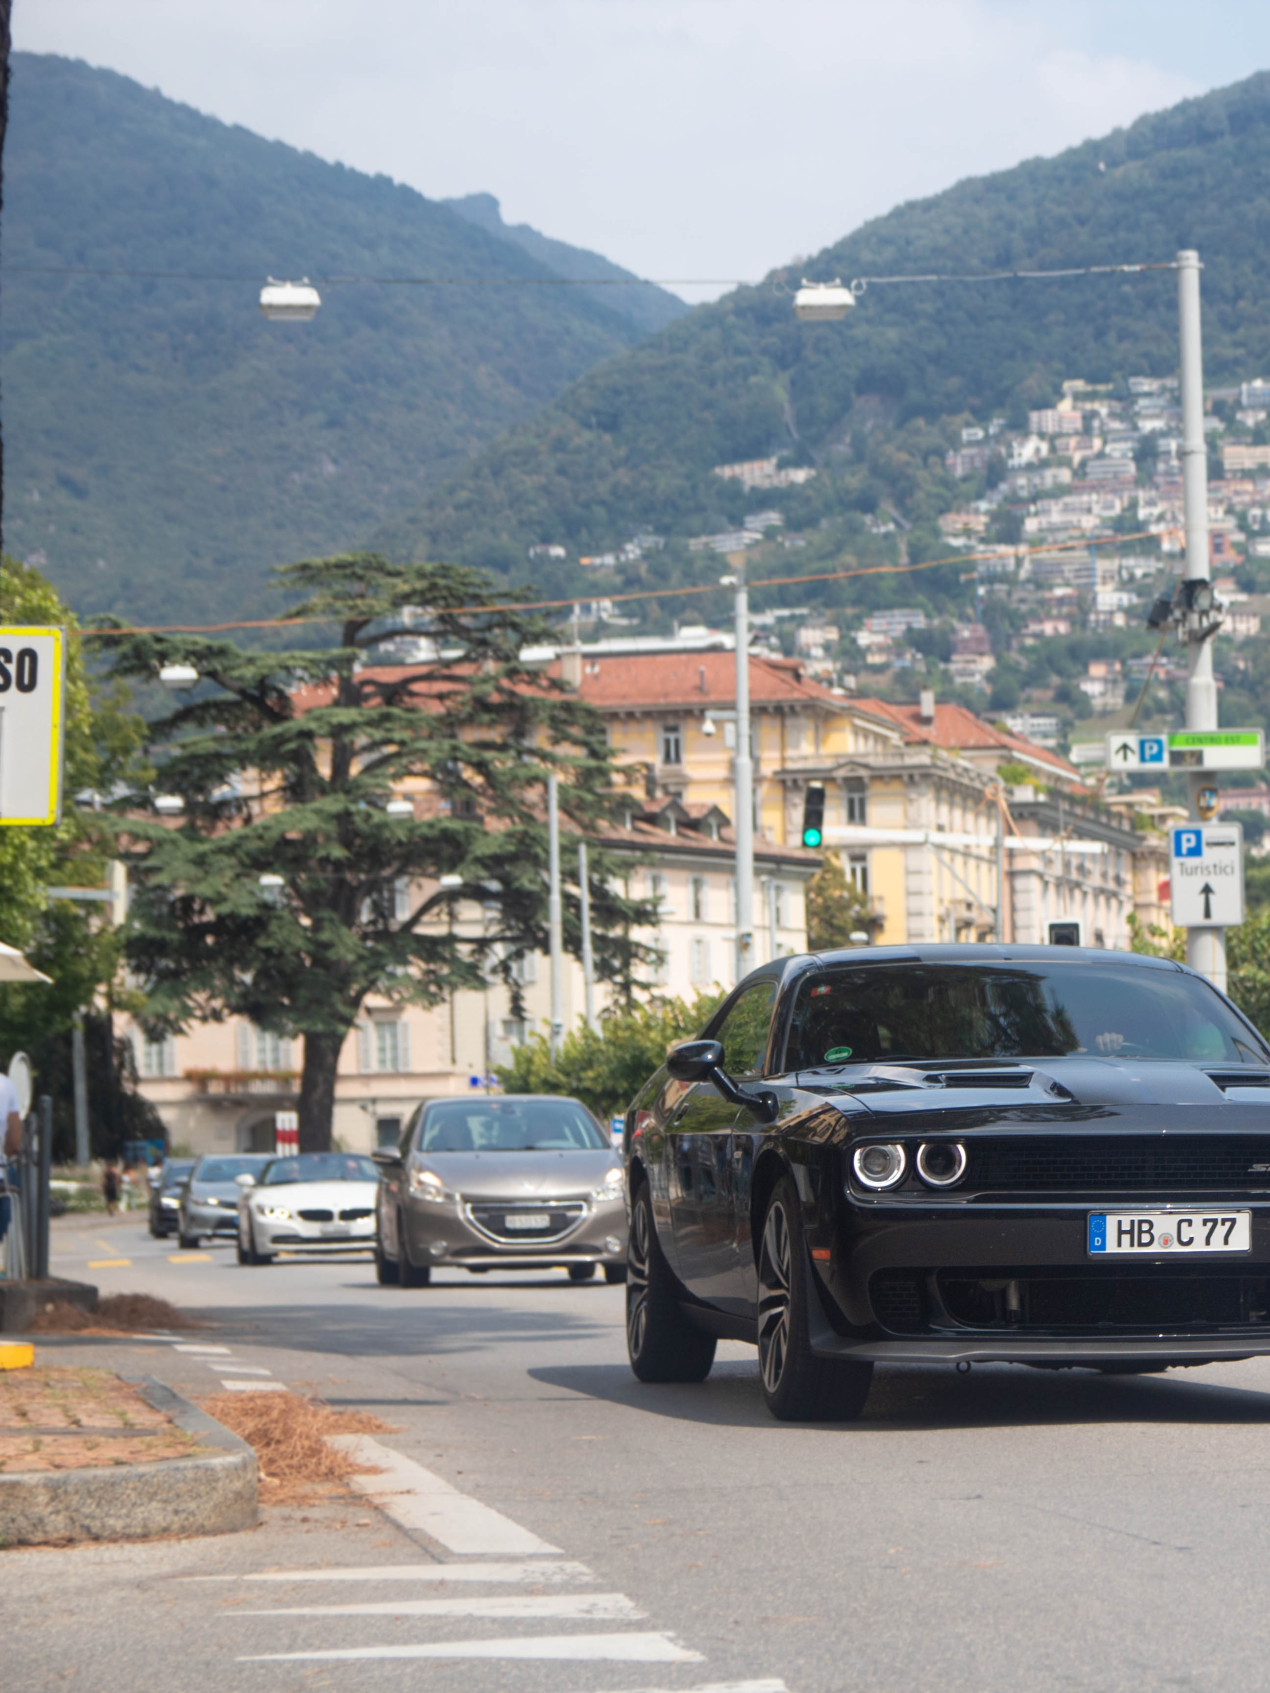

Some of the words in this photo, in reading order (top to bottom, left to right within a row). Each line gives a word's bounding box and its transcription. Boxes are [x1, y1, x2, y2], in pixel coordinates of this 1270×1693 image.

[1145, 742, 1159, 760] P
[1185, 735, 1223, 745] CENTRO
[1225, 735, 1241, 744] EST
[1181, 833, 1196, 855] P
[1178, 861, 1235, 877] Turistici
[1094, 1237, 1102, 1246] D
[1117, 1219, 1155, 1248] HB
[1176, 1218, 1194, 1247] C
[1202, 1217, 1237, 1246] 77
